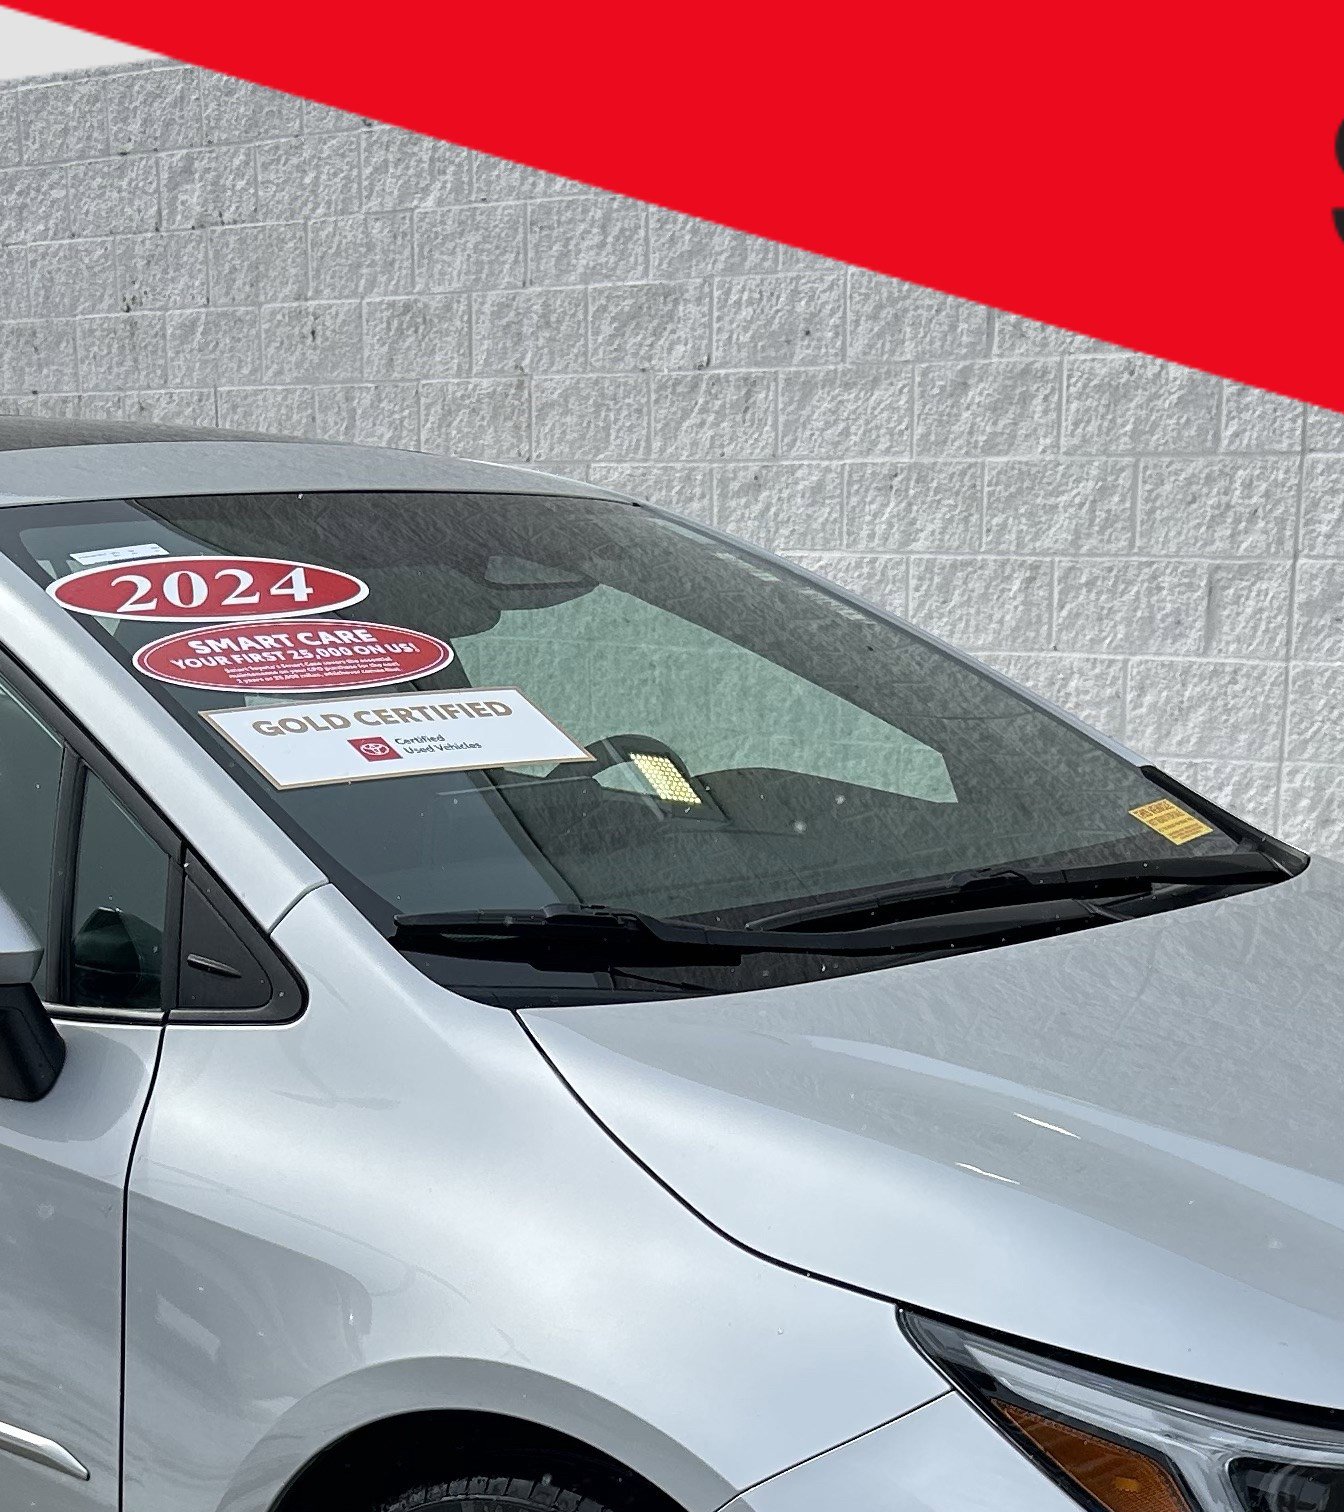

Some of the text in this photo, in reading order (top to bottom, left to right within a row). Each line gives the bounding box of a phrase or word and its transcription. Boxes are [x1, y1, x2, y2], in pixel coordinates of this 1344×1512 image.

[111, 567, 314, 613] 2024
[188, 628, 378, 655] SMART CARE
[170, 641, 421, 671] YOUR FIRST 25,000 ON US!
[252, 701, 513, 737] GOLD CERTIFIED
[394, 734, 446, 746] Certified
[403, 740, 483, 755] Used Vehicles
